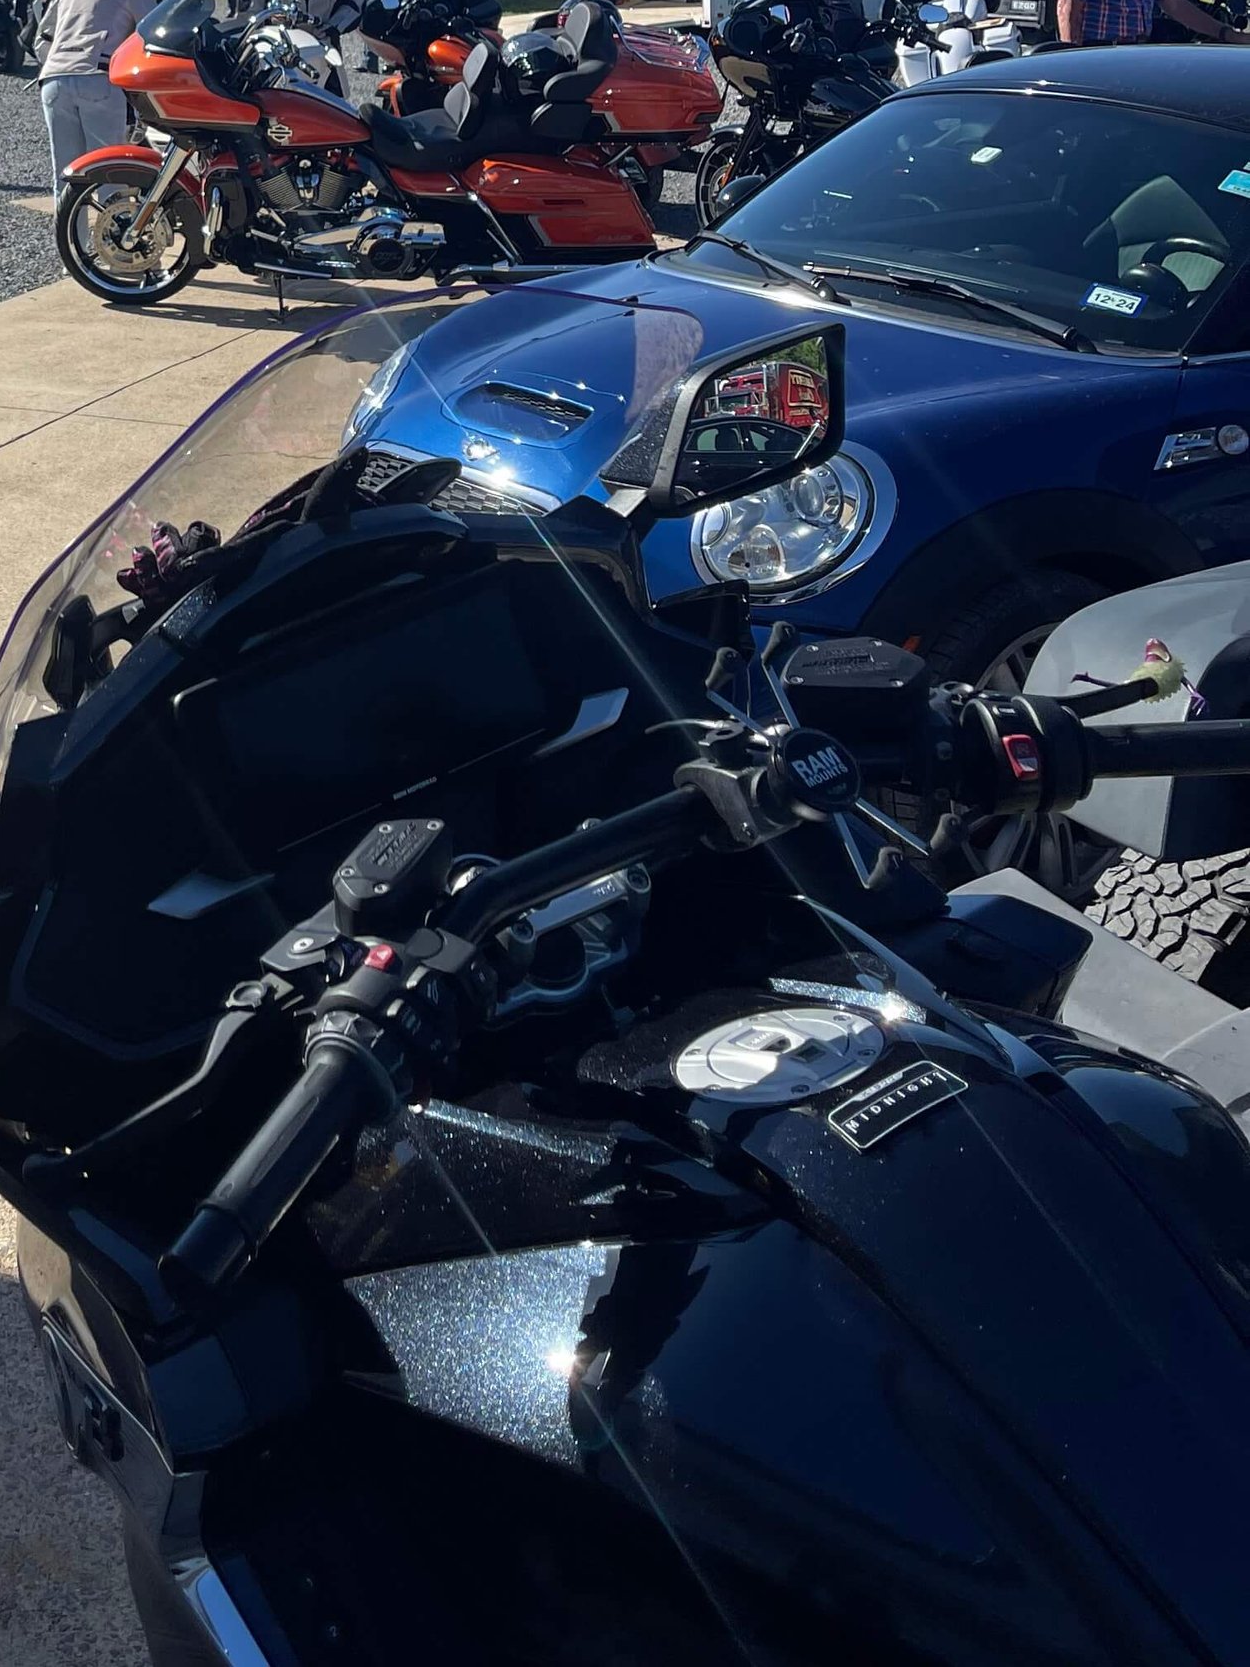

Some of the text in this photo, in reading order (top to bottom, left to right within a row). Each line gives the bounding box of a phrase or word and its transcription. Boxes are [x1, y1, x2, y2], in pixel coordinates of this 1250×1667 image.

[791, 746, 841, 777] RAM
[804, 763, 849, 788] MOUNTS
[845, 1071, 947, 1134] MIDNIGHT
